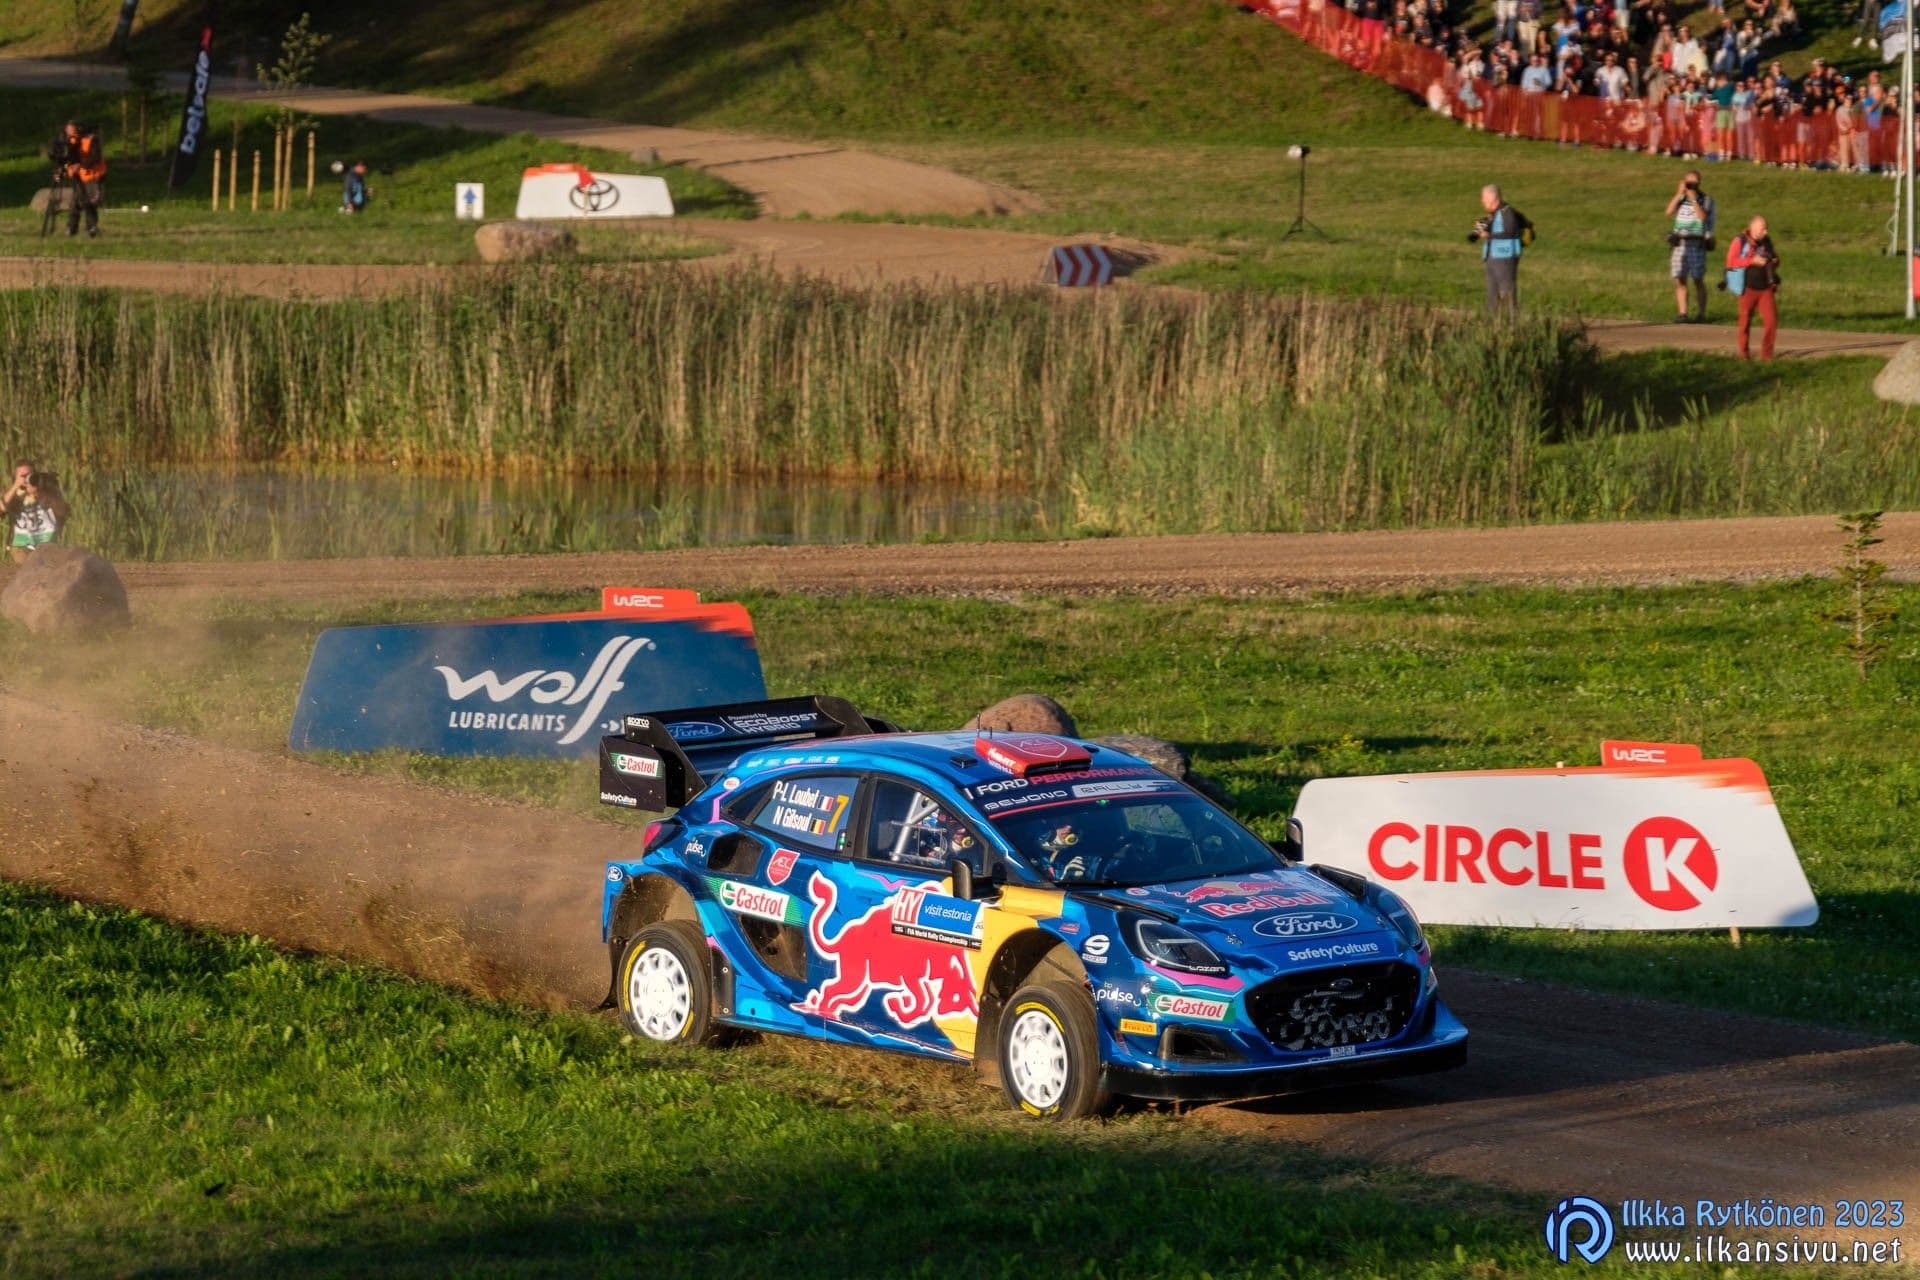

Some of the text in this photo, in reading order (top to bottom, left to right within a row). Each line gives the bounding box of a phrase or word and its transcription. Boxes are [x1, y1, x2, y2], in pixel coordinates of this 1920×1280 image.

[613, 594, 664, 608] WRC
[448, 711, 566, 733] LUBRICANTS
[1612, 747, 1666, 763] WRC
[627, 759, 656, 774] Castrol
[790, 784, 819, 808] Loubet
[976, 778, 1029, 796] FORD
[984, 789, 1068, 810] BEYOND
[773, 806, 812, 832] N Gilsoul
[828, 795, 849, 833] 7
[1367, 822, 1606, 890] CIRCLE
[736, 887, 783, 917] Castrol
[924, 904, 972, 922] visit estonia
[1273, 915, 1342, 935] Ford
[1288, 941, 1378, 962] SafetyCulture
[1097, 988, 1134, 1003] pulse
[1172, 1000, 1223, 1018] Castrol
